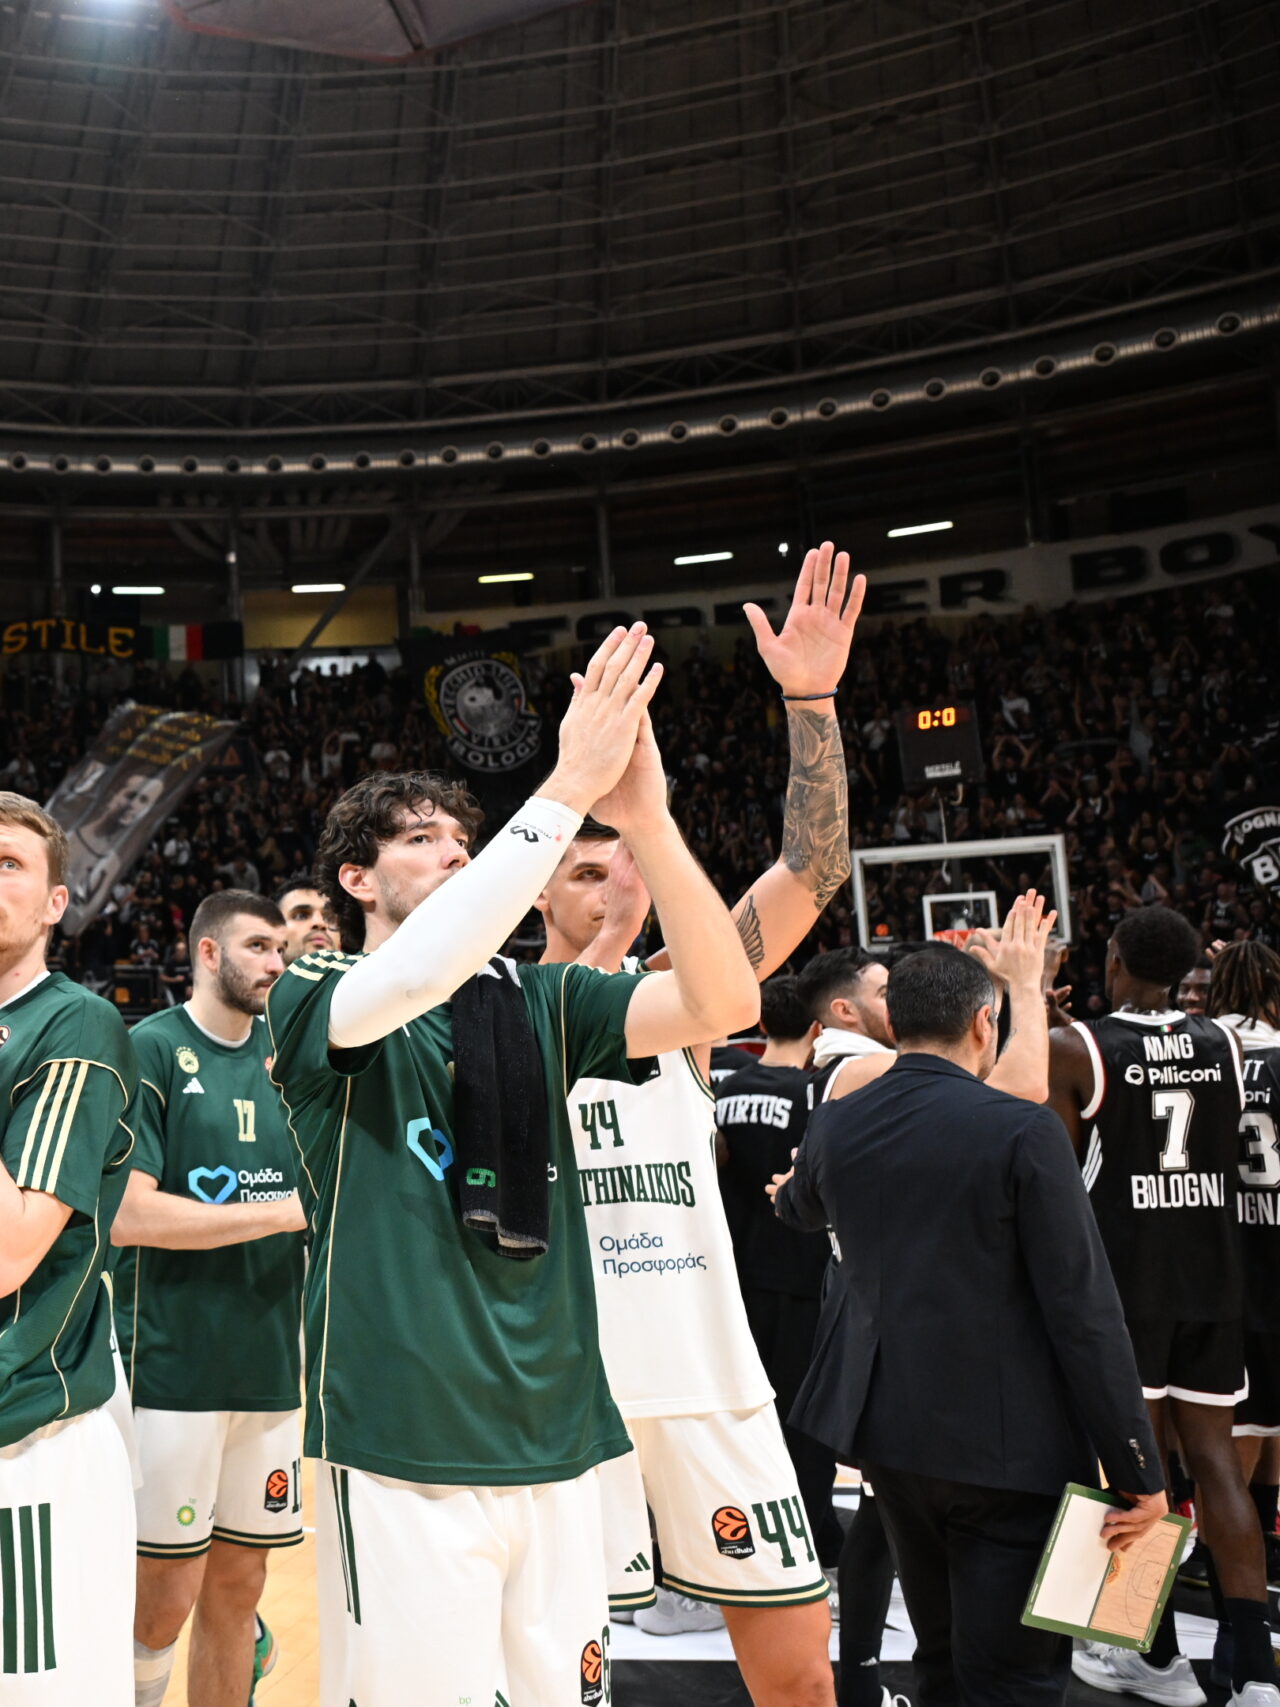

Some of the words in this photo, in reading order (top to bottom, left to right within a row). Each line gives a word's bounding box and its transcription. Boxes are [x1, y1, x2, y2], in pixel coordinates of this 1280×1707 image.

[1, 616, 135, 658] STILE
[578, 1099, 624, 1150] 44
[716, 1094, 793, 1130] VIRTUS
[1151, 1088, 1195, 1172] 7
[238, 1168, 283, 1187] Ομάδα
[577, 1160, 696, 1208] THINAIKOS
[1131, 1172, 1225, 1210] BOLOGN
[599, 1232, 664, 1255] Ομάδα
[602, 1253, 707, 1278] Προσφοράς
[751, 1494, 816, 1568] 44
